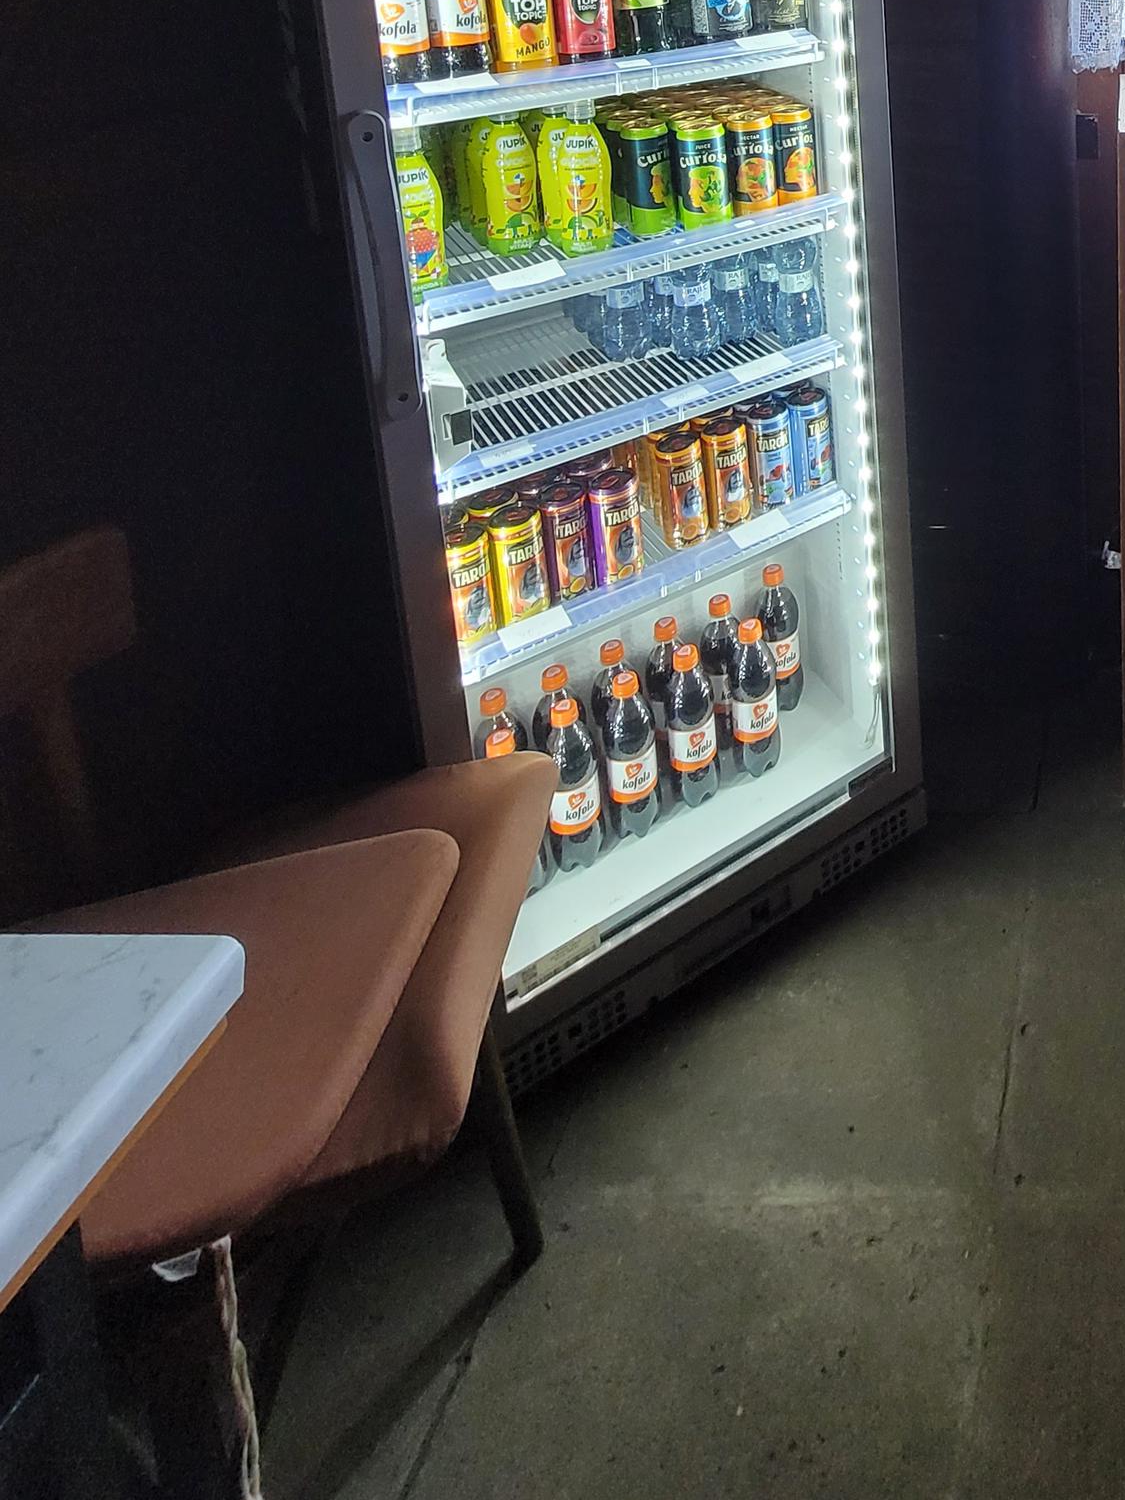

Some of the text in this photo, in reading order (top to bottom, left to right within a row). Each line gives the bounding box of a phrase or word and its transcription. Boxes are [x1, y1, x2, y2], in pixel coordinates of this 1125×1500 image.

[578, 4, 597, 12] TOPIC
[516, 37, 551, 57] MANGO
[565, 133, 595, 149] JUPÍK
[695, 143, 712, 151] JUICE
[751, 711, 775, 730] kofola
[687, 739, 713, 759] kofola
[622, 771, 651, 790] kofola
[565, 800, 595, 821] kofola
